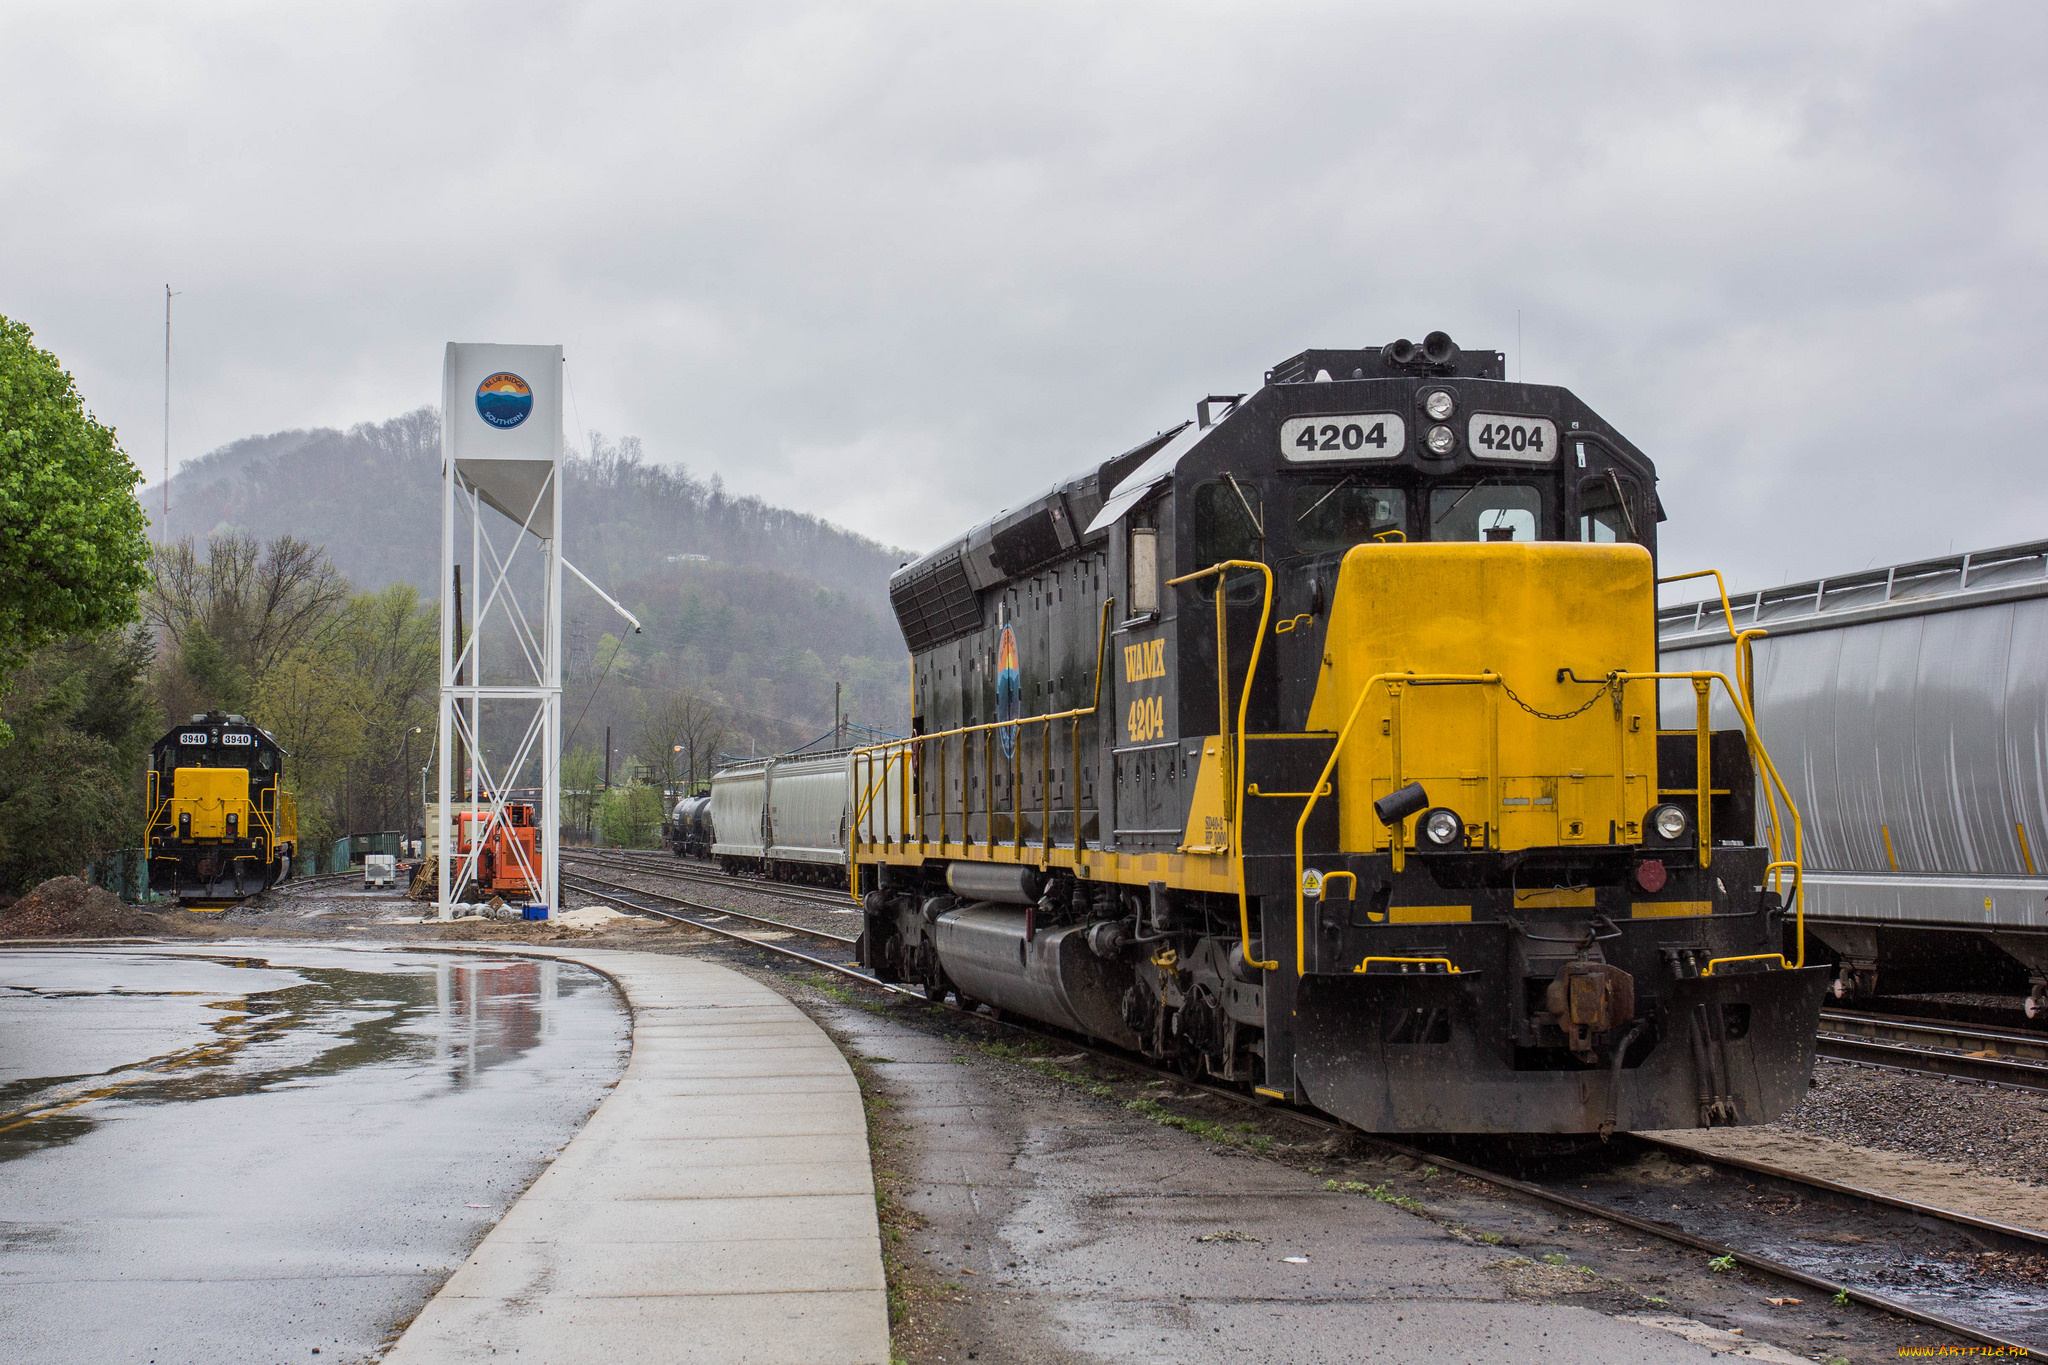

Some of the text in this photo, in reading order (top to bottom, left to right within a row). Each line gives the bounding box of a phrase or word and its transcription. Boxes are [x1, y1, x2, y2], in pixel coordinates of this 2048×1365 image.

[484, 375, 525, 390] BLUE RIDGE
[484, 411, 524, 426] SOUTHERN
[1296, 422, 1388, 452] 4204
[1478, 423, 1544, 452] 4204
[1124, 638, 1166, 683] WAMX
[1127, 695, 1164, 742] 4204
[182, 734, 206, 744] 3940
[225, 735, 249, 744] 3940
[1205, 831, 1213, 845] HP
